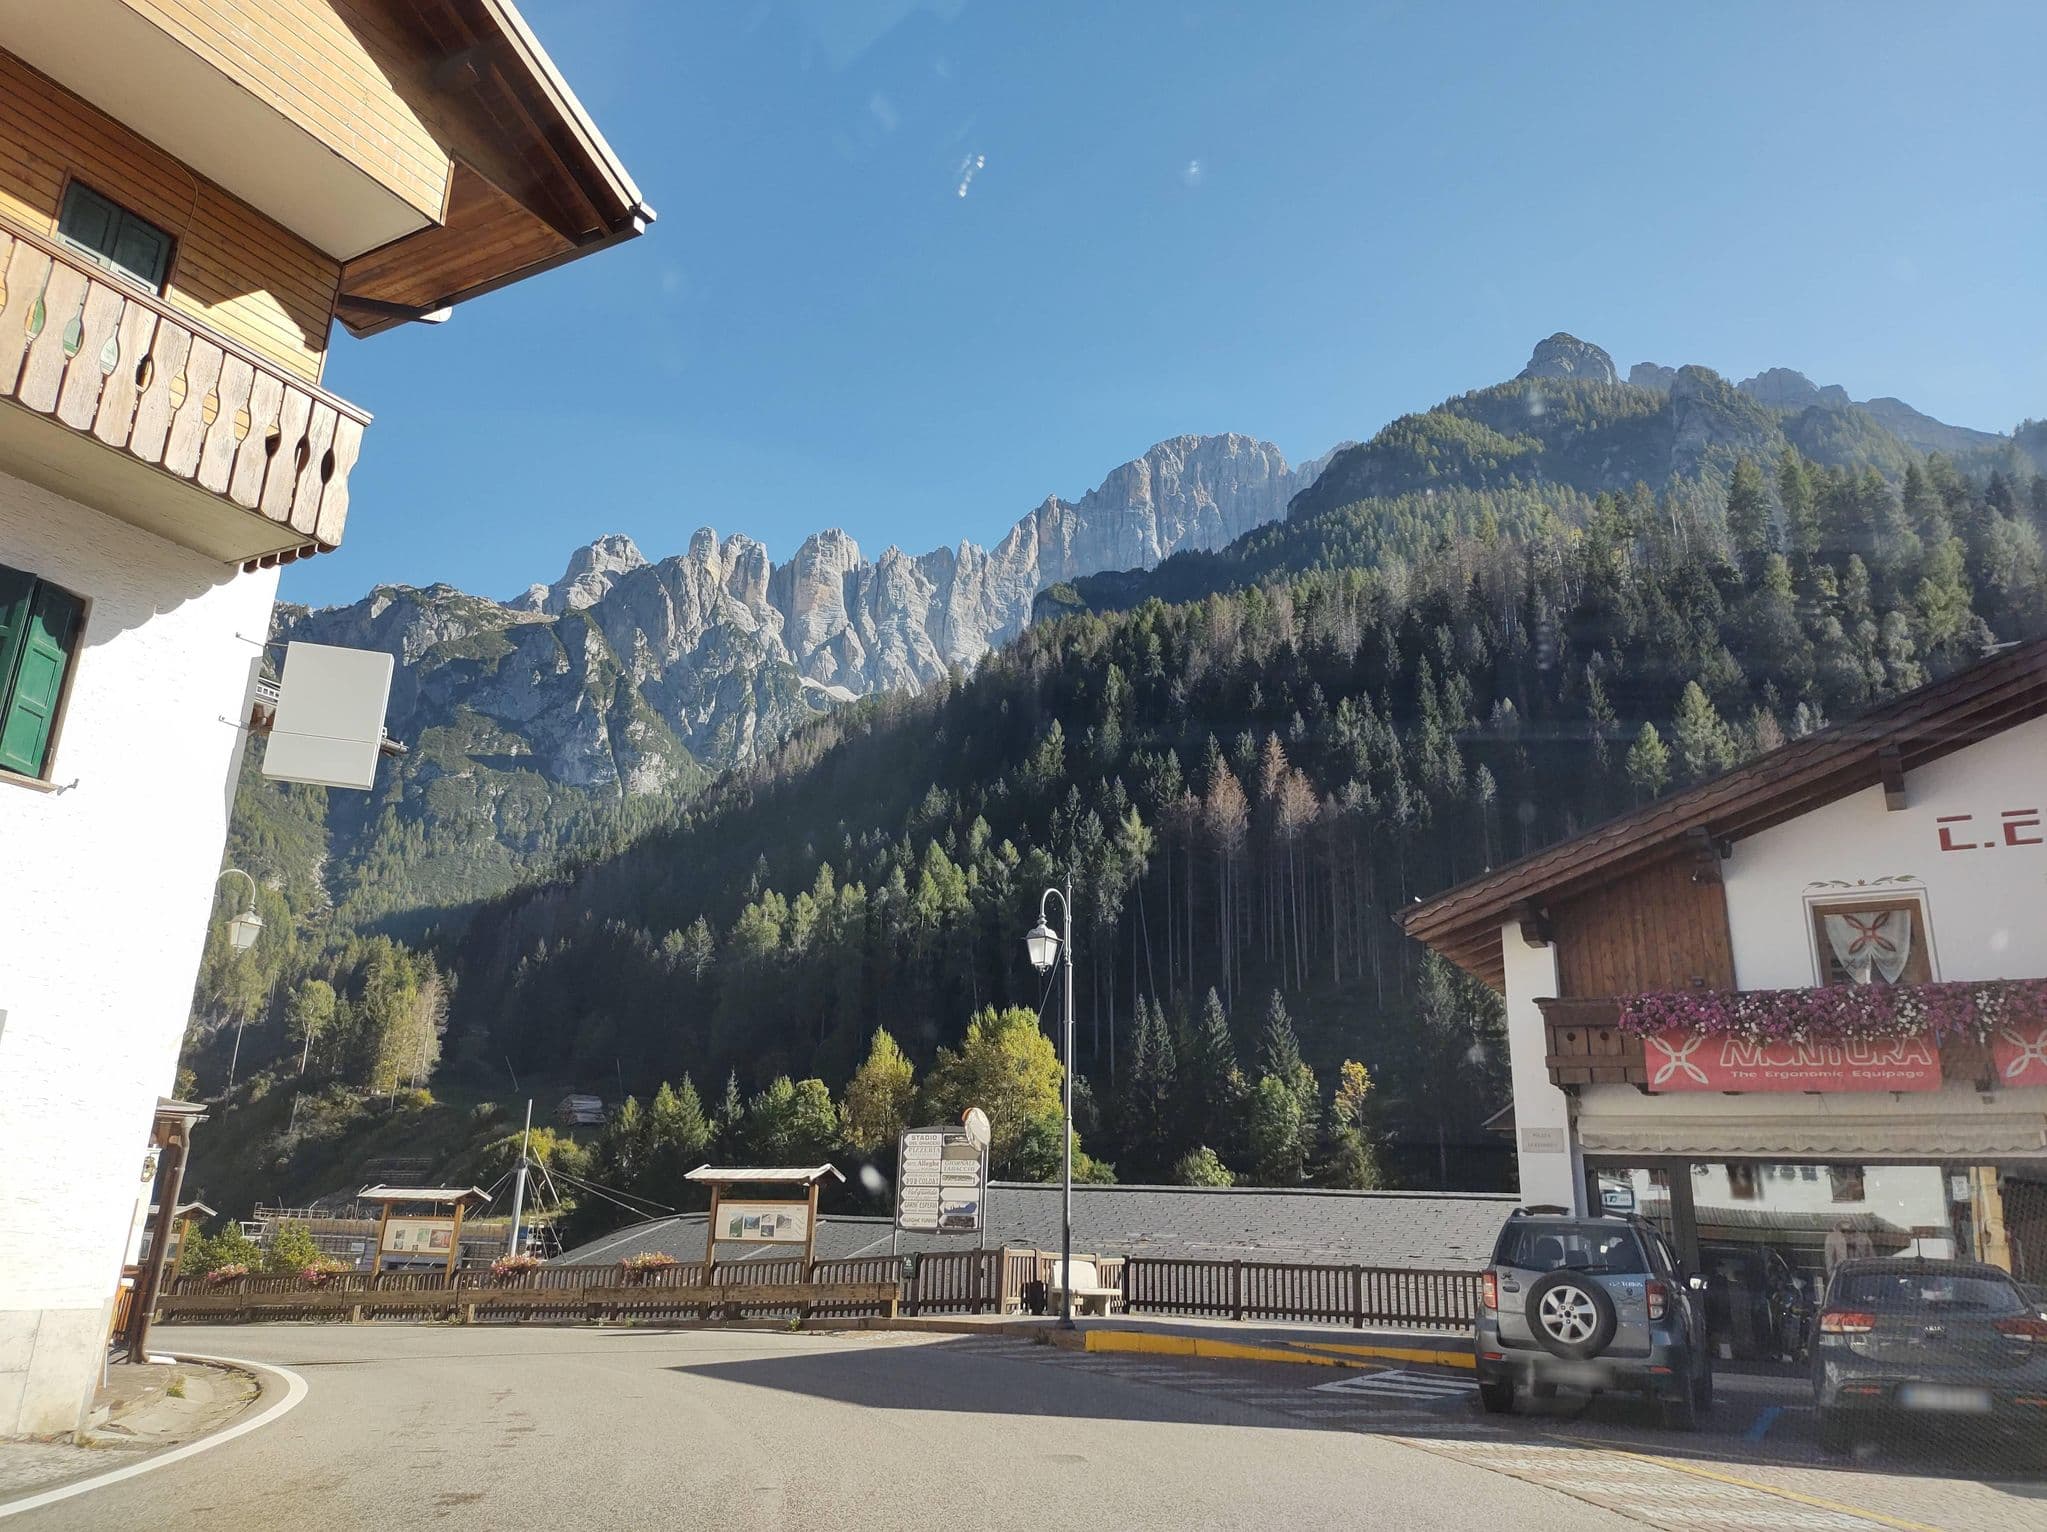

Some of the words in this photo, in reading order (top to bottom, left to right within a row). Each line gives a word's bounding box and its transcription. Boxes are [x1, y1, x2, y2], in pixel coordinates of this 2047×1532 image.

[1719, 1037, 1932, 1067] MONTURA
[1765, 1070, 1844, 1079] Ergonomic
[1852, 1070, 1925, 1079] Equipage
